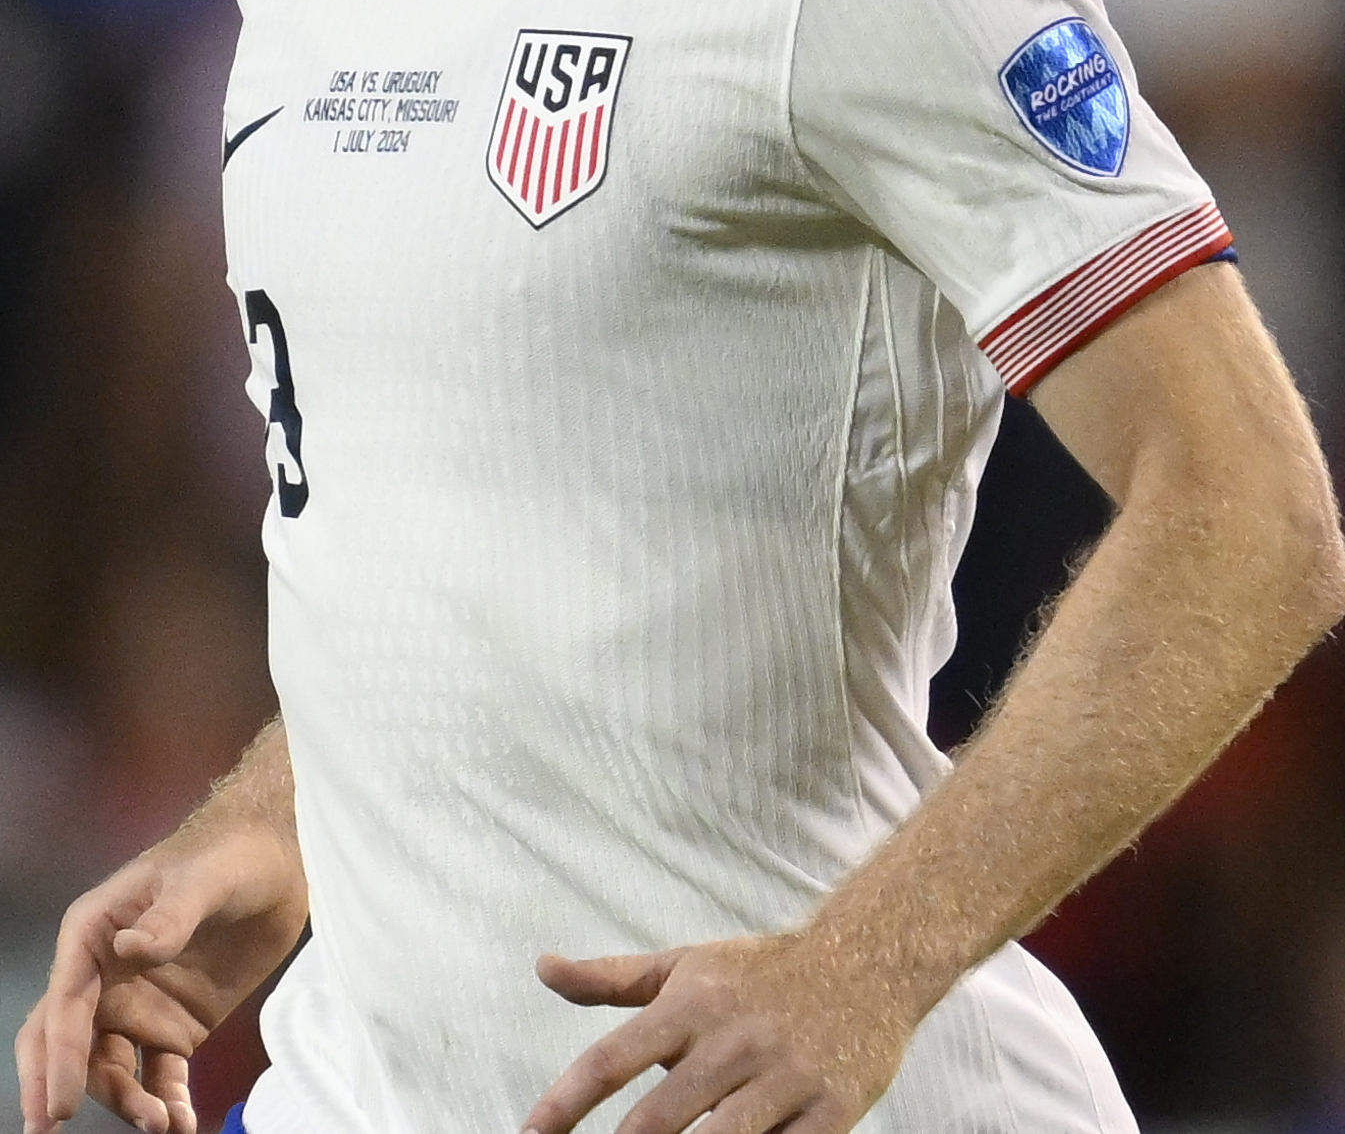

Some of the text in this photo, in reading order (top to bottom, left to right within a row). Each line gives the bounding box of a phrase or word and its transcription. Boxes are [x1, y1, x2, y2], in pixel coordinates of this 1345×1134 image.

[329, 71, 355, 94] USA
[382, 70, 443, 94] URUGUAY
[515, 42, 618, 113] USA
[1031, 53, 1106, 112] ROCKING
[303, 98, 460, 123] KANSAS CITY, MISSOURI
[1035, 72, 1113, 124] THE CONTINENT
[341, 130, 375, 153] JULY
[376, 130, 411, 153] 2024
